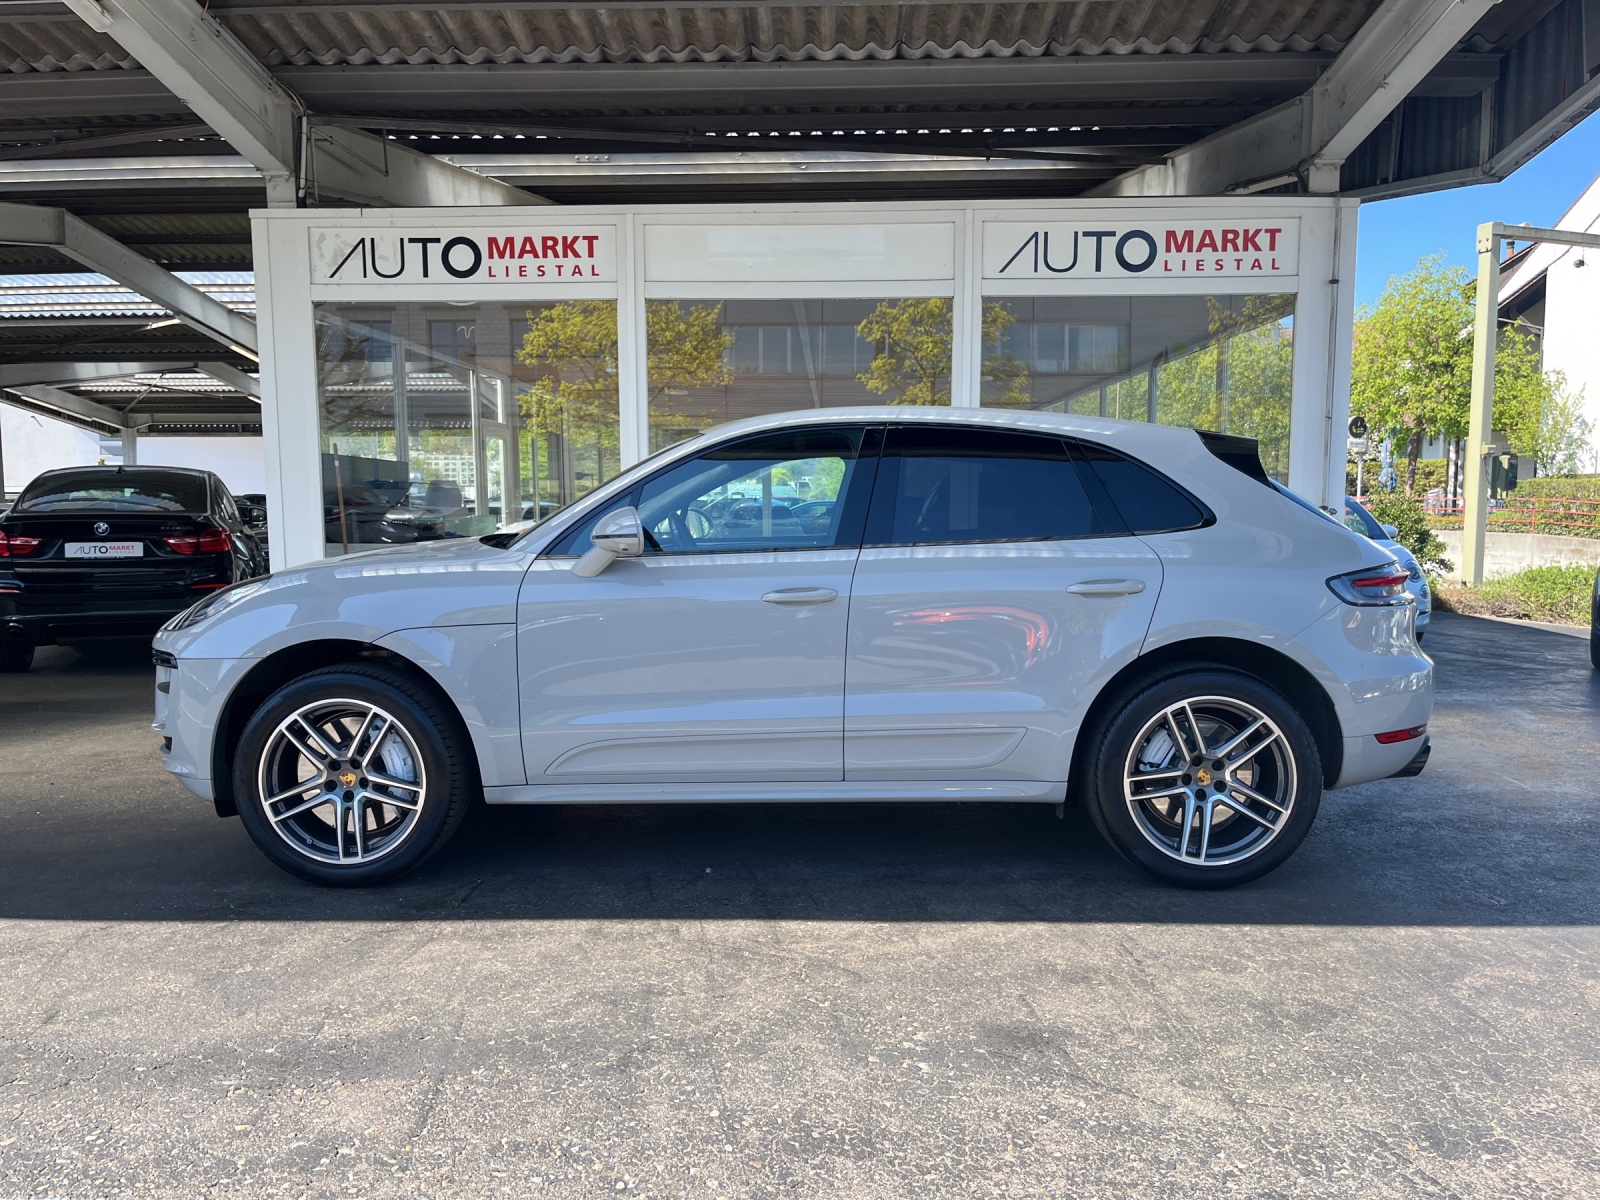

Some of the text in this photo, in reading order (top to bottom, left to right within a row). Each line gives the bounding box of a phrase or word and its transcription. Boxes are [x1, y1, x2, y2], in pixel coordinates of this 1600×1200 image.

[329, 235, 599, 278] AUTO MARKT
[998, 228, 1282, 273] AUTO MARKT
[488, 264, 600, 278] LIESTAL
[1164, 257, 1281, 272] LIESTAL
[74, 545, 108, 555] AUTO
